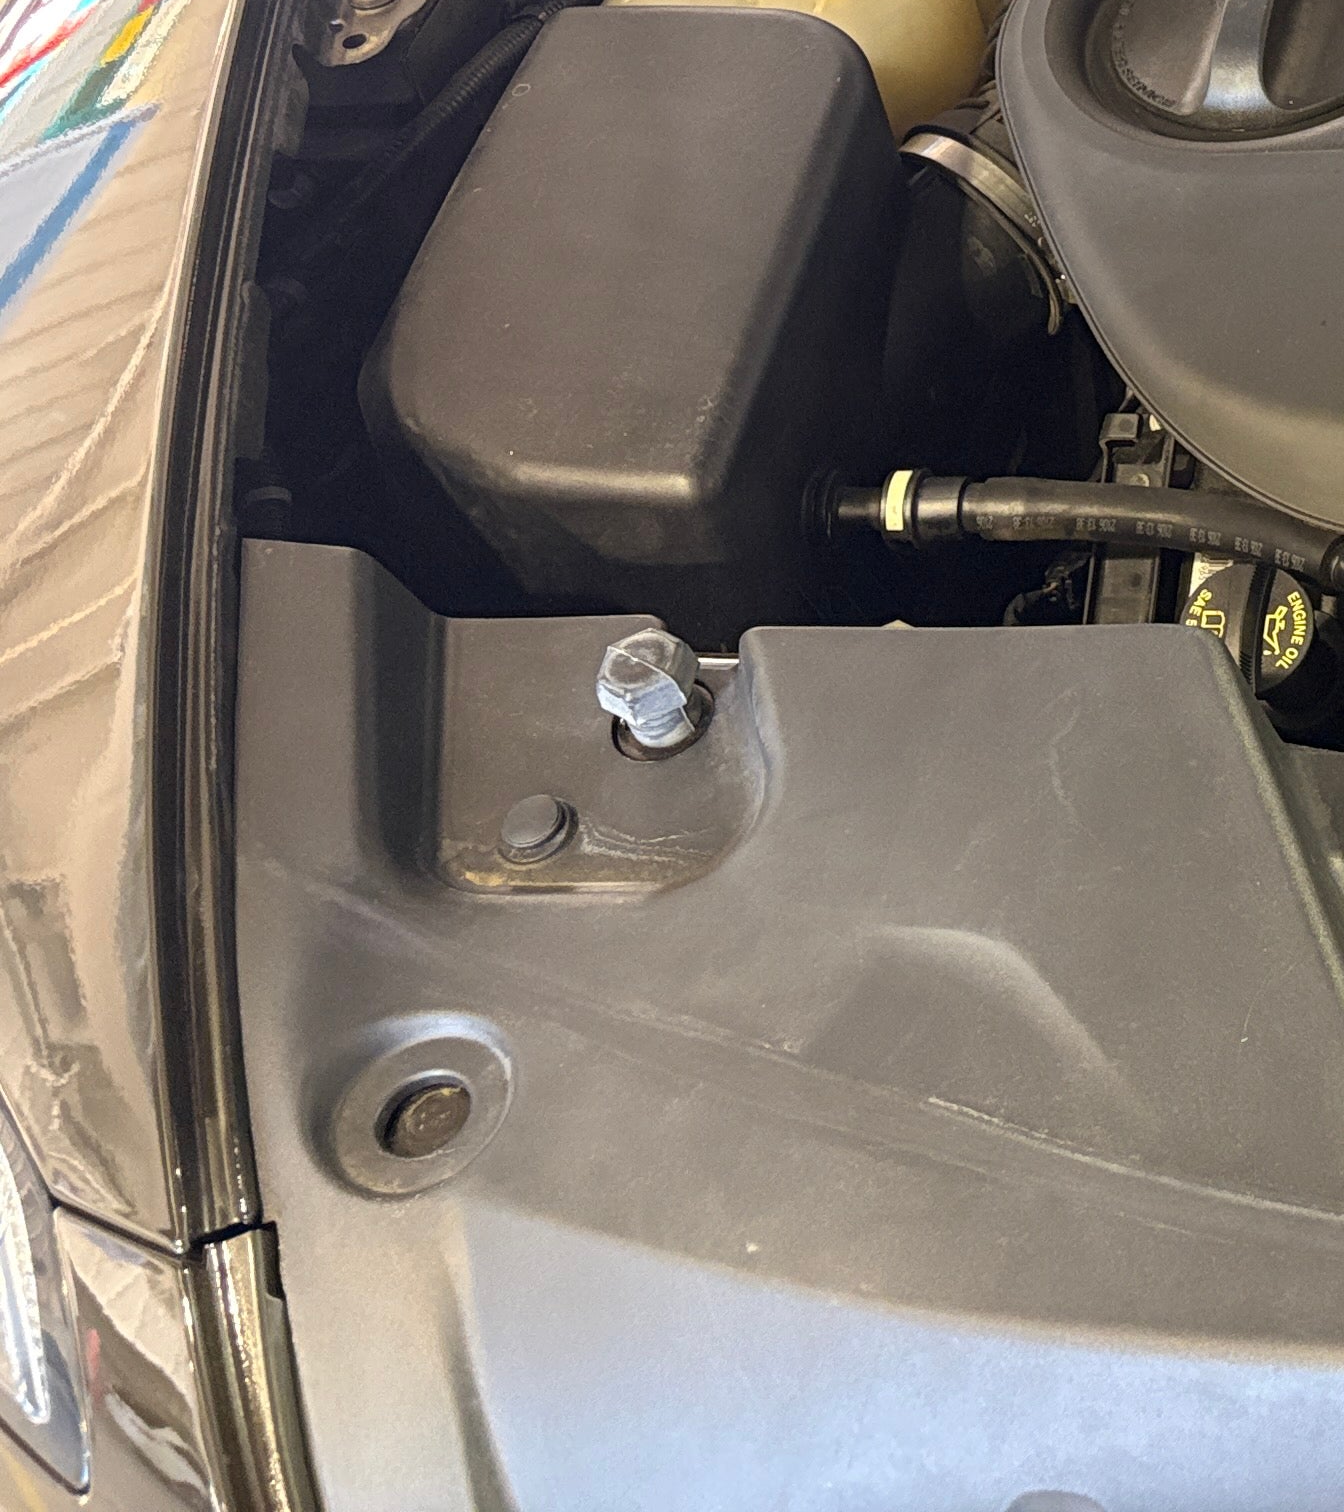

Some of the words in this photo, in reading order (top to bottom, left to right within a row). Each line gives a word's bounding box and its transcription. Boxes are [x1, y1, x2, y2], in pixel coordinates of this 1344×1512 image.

[1189, 589, 1212, 616] SAE
[1287, 591, 1307, 646] ENGINE
[1275, 647, 1299, 670] OIL
